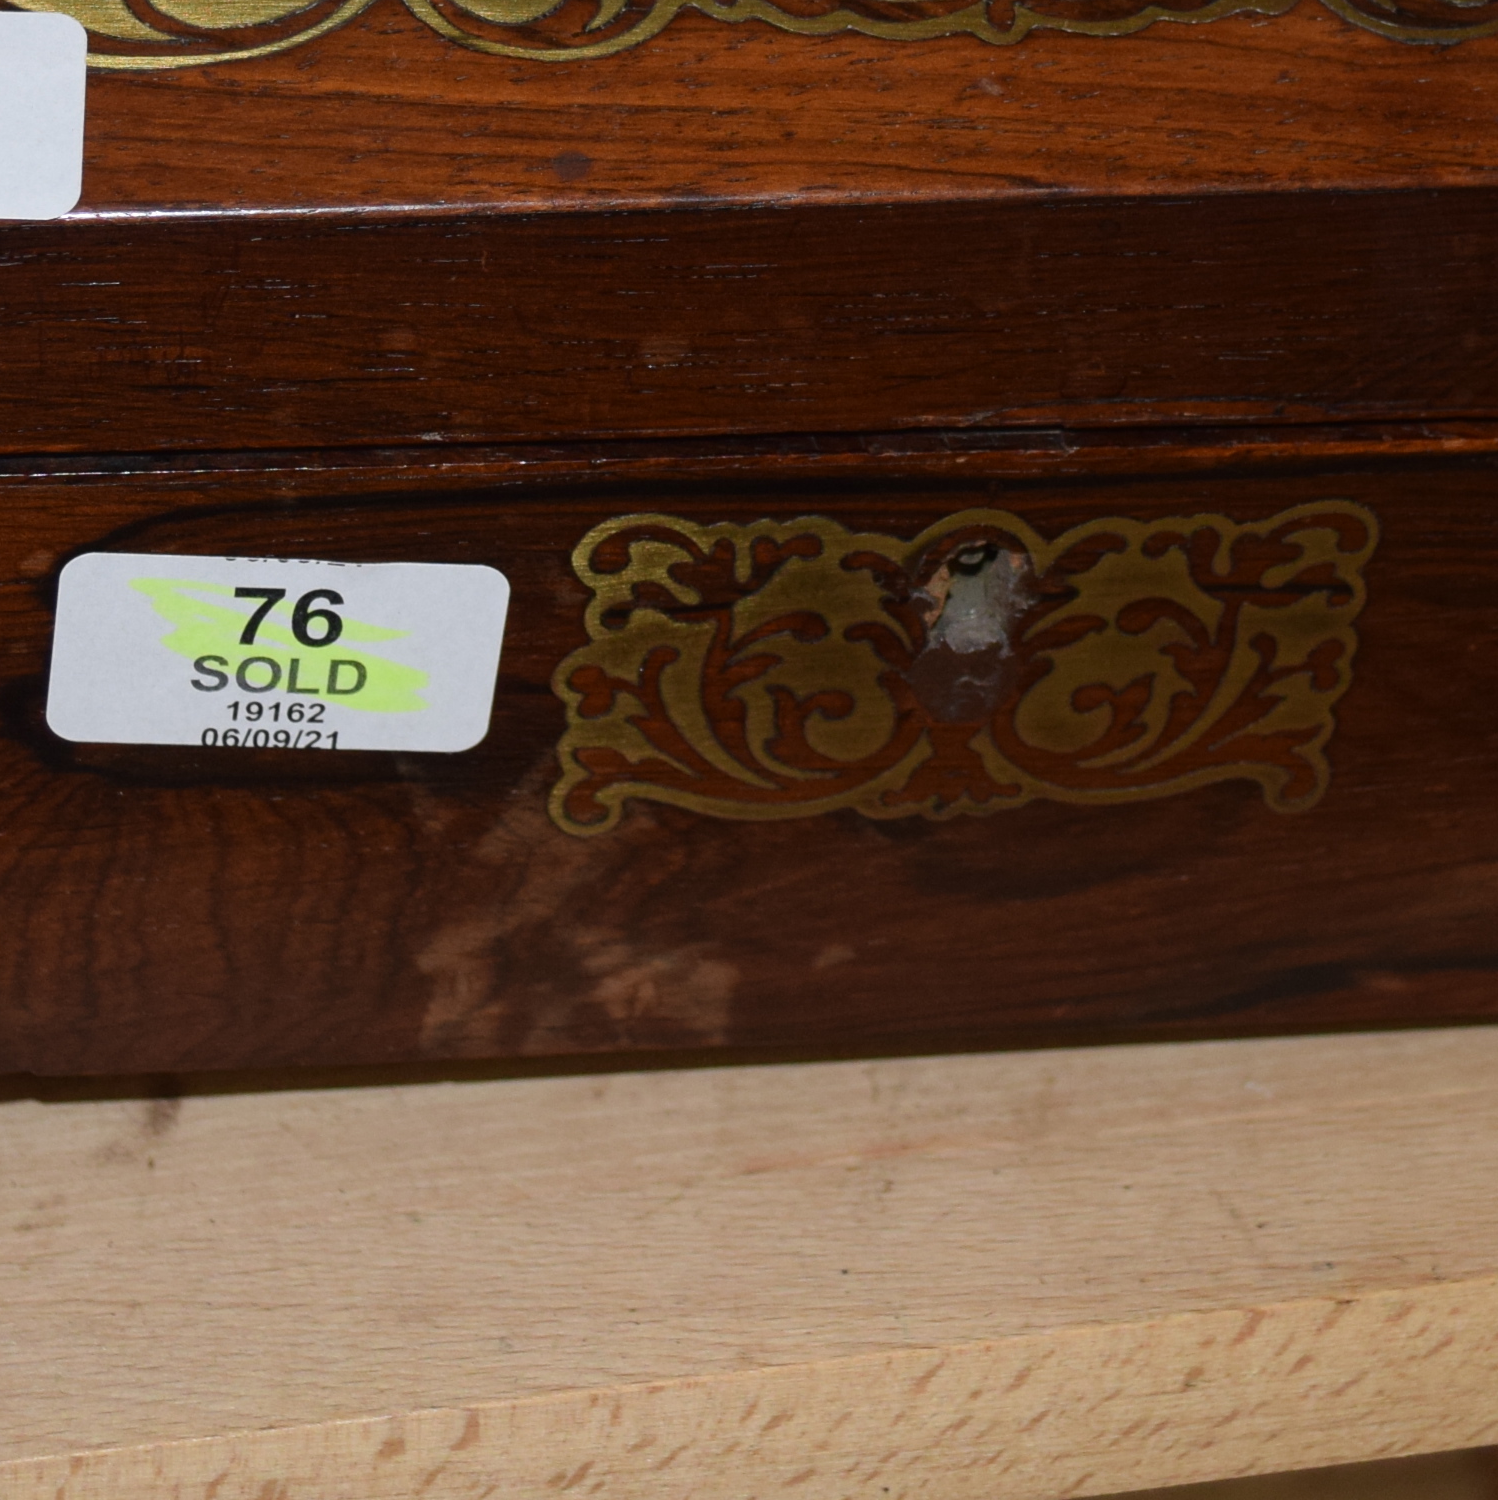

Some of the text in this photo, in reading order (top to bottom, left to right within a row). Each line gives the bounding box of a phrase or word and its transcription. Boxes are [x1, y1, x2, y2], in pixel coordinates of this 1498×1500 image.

[233, 586, 345, 648] 76
[190, 654, 368, 696] SOLD
[226, 700, 326, 723] 19162
[201, 727, 339, 749] 06/09/21
